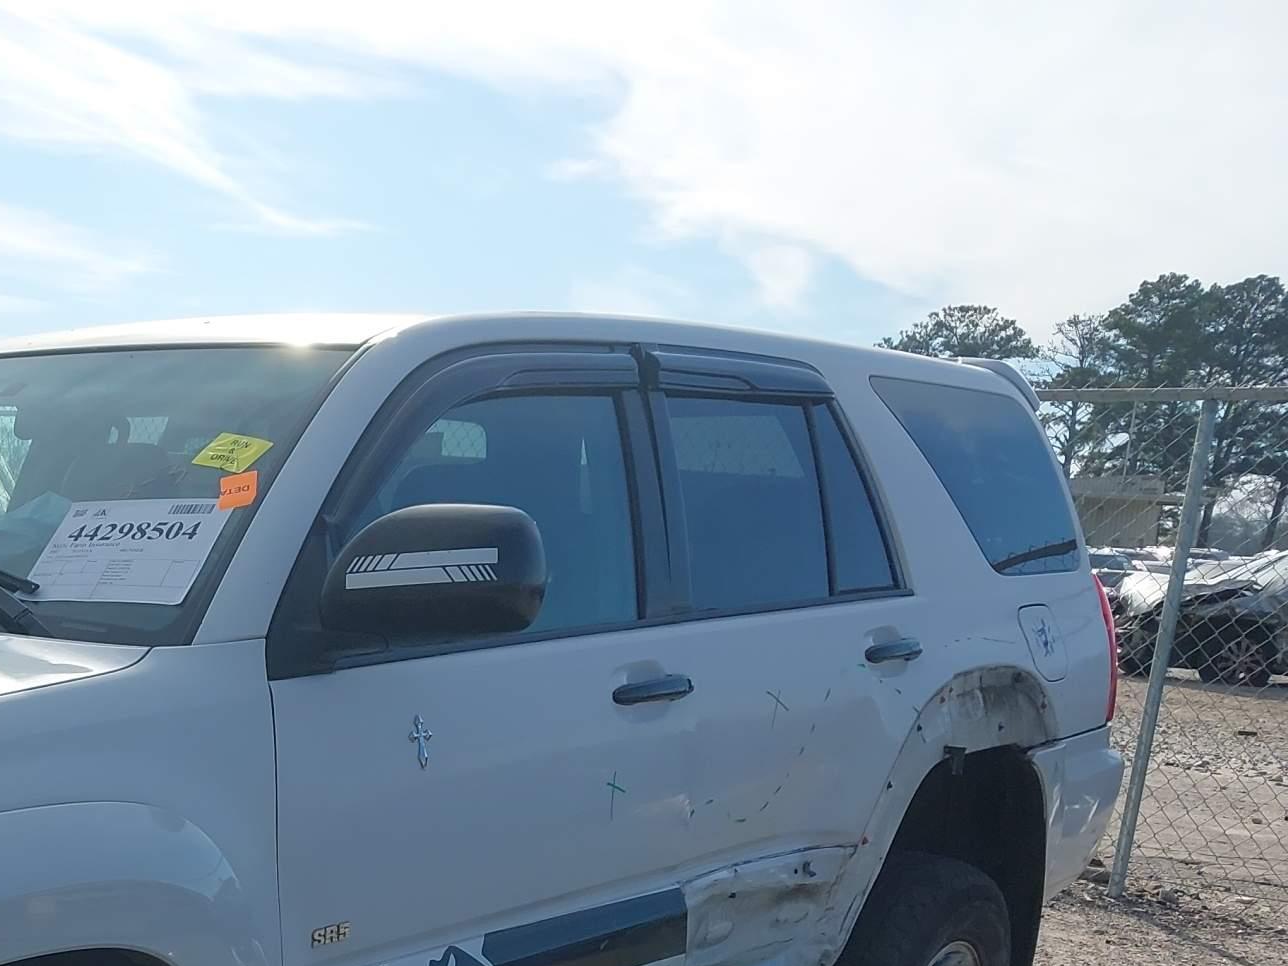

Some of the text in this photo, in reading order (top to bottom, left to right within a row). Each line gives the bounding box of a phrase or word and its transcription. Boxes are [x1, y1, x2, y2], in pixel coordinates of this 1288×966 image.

[230, 439, 250, 449] RUN
[210, 453, 238, 465] DRIVE
[67, 520, 202, 542] 44298504
[311, 921, 352, 948] SR5
